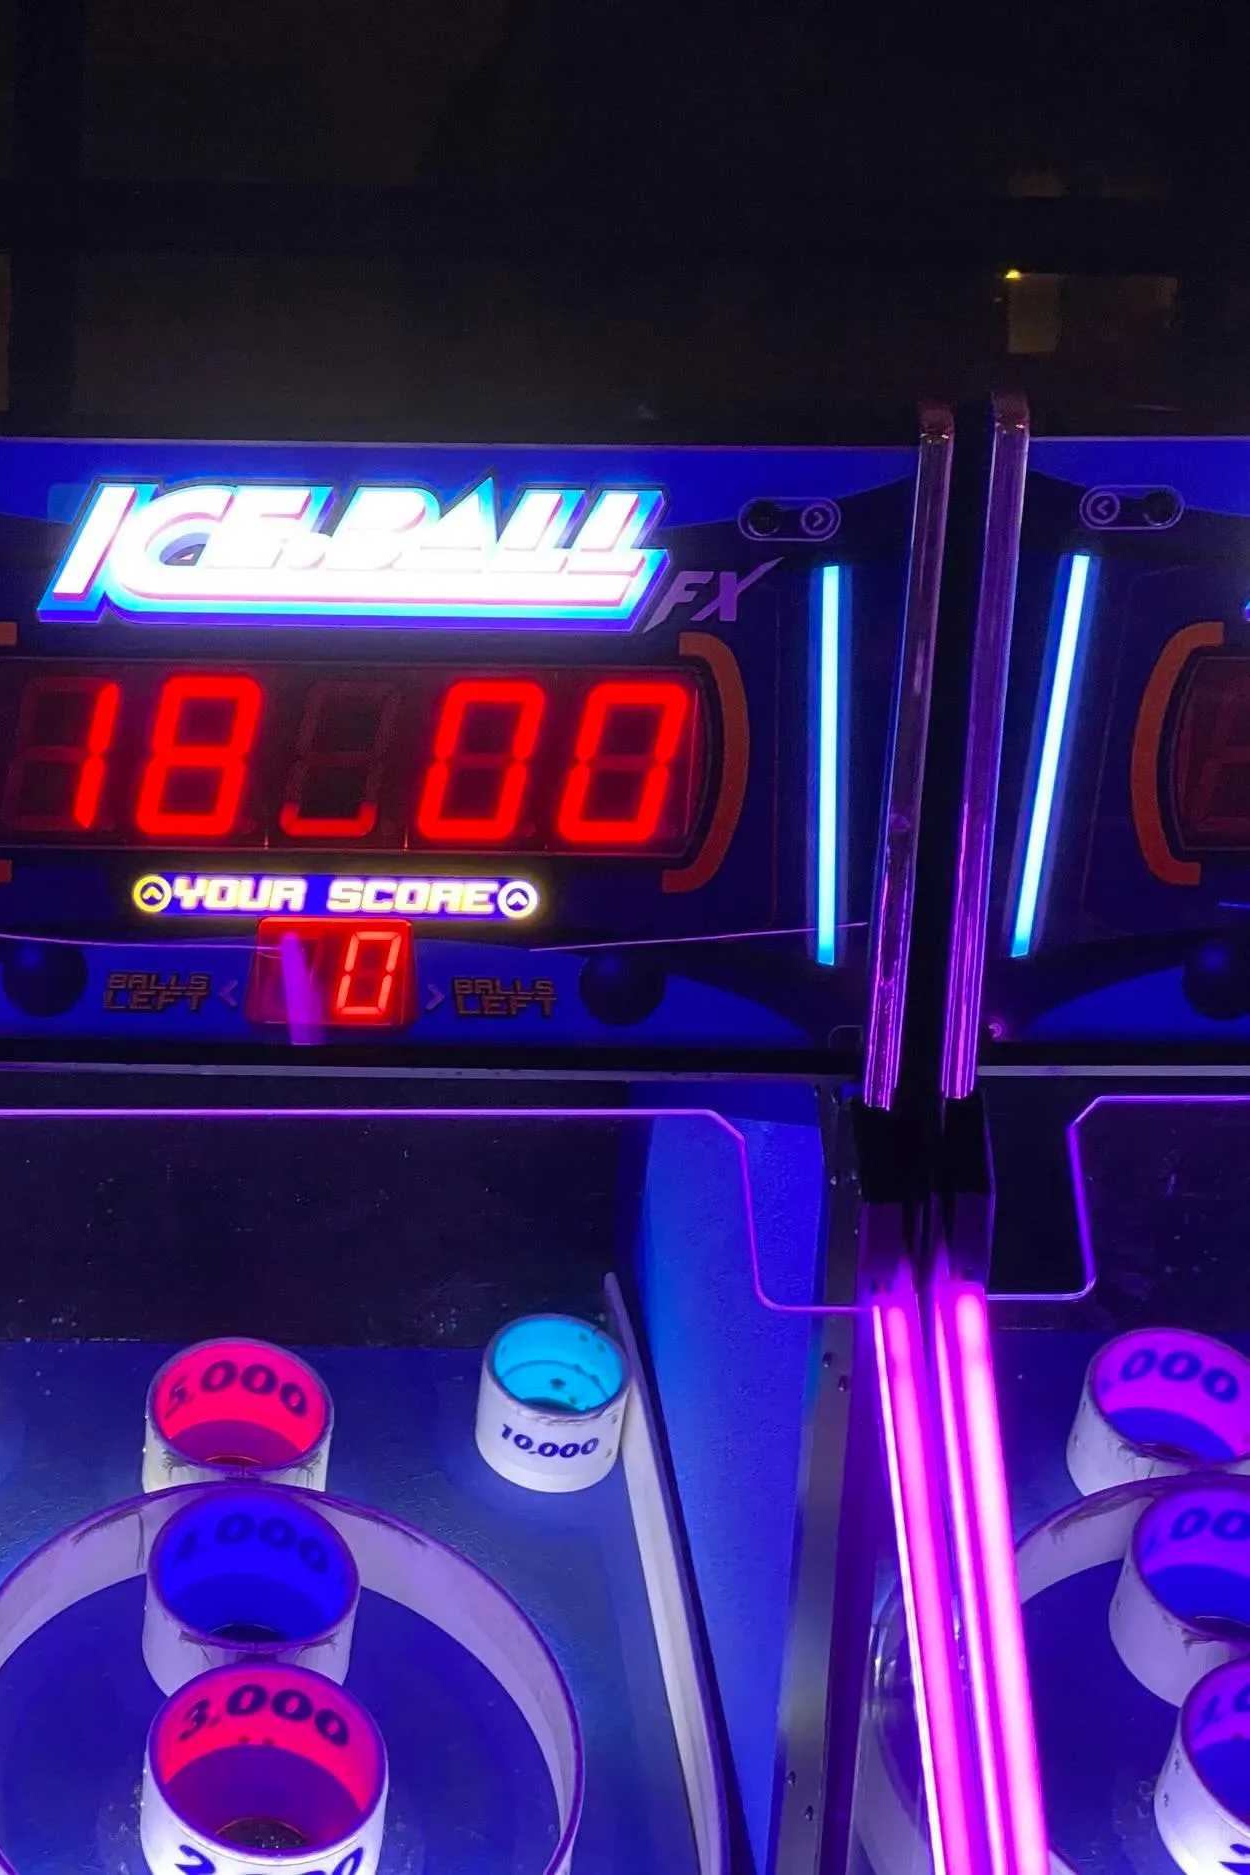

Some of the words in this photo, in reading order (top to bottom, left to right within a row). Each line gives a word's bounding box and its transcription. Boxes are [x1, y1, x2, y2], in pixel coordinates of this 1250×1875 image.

[643, 556, 784, 633] FX
[174, 876, 308, 912] YOUR
[327, 879, 501, 915] SCORE
[107, 971, 211, 991] BALLS
[335, 929, 403, 1016] 0
[453, 976, 556, 996] BALLS
[102, 989, 211, 1012] LEFT
[455, 993, 558, 1017] LEFT
[501, 1422, 600, 1459] 10,000
[178, 1683, 349, 1747] 3,000
